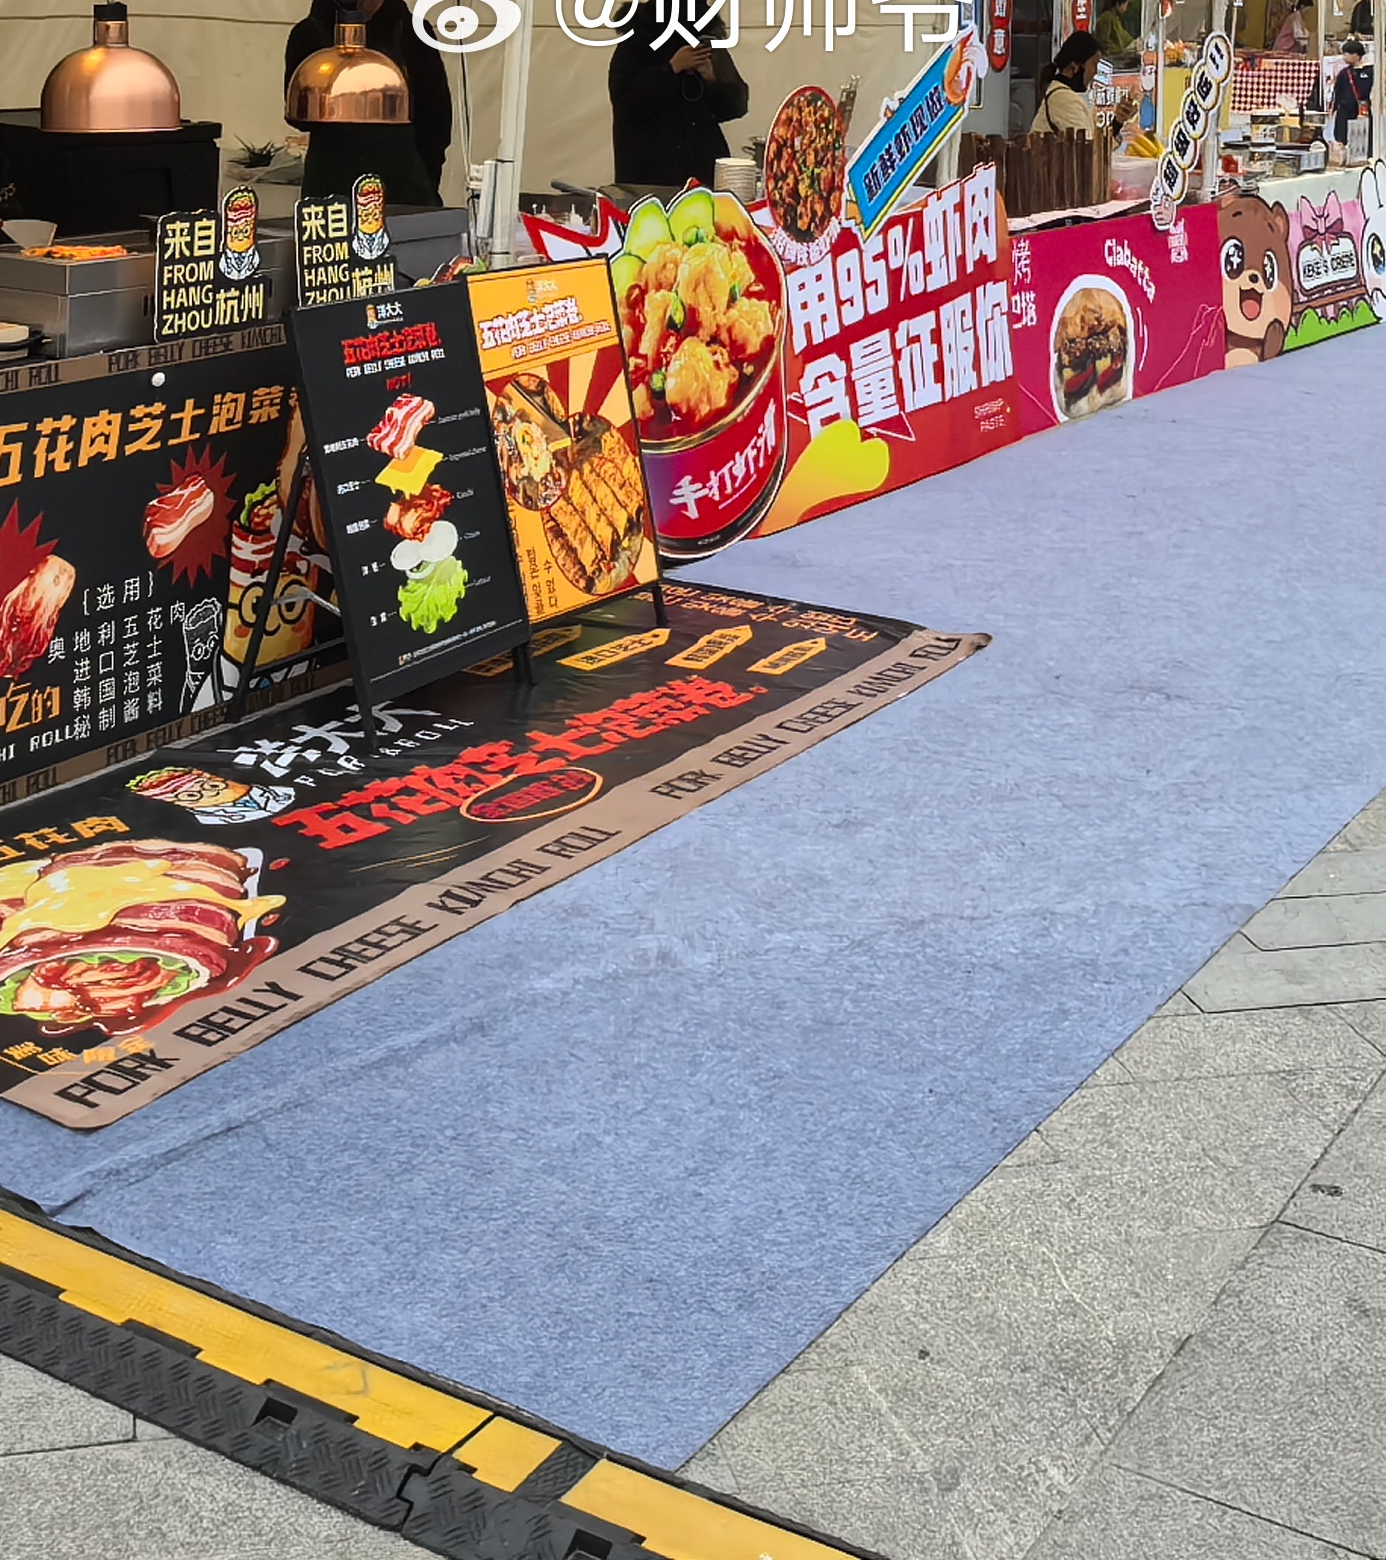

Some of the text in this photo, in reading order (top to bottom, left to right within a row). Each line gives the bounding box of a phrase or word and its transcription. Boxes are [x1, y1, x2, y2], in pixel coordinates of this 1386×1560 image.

[164, 218, 216, 260] 来自
[301, 202, 349, 241] 来自
[163, 260, 214, 286] FROM
[302, 242, 349, 266] FROM
[789, 168, 997, 354] 用95%虾肉
[303, 264, 350, 288] HANG
[163, 285, 213, 310] HANG
[215, 284, 263, 325] 杭州
[162, 309, 212, 335] ZHOU
[798, 280, 1013, 440] 含量征服你
[669, 402, 777, 519] 手打虾滑
[47, 600, 186, 664] 奥地利五花肉
[73, 634, 163, 684] 进口芝士
[73, 661, 163, 712] 韩国泡菜
[73, 689, 163, 740] 秘制酱料
[29, 724, 76, 752] ROLL
[710, 733, 792, 769] BELLY
[56, 1046, 180, 1110] PORK
[174, 980, 304, 1046] BELLY
[297, 915, 439, 982] CHEESE
[427, 858, 550, 914] KIMCHI
[536, 826, 622, 859] ROLL
